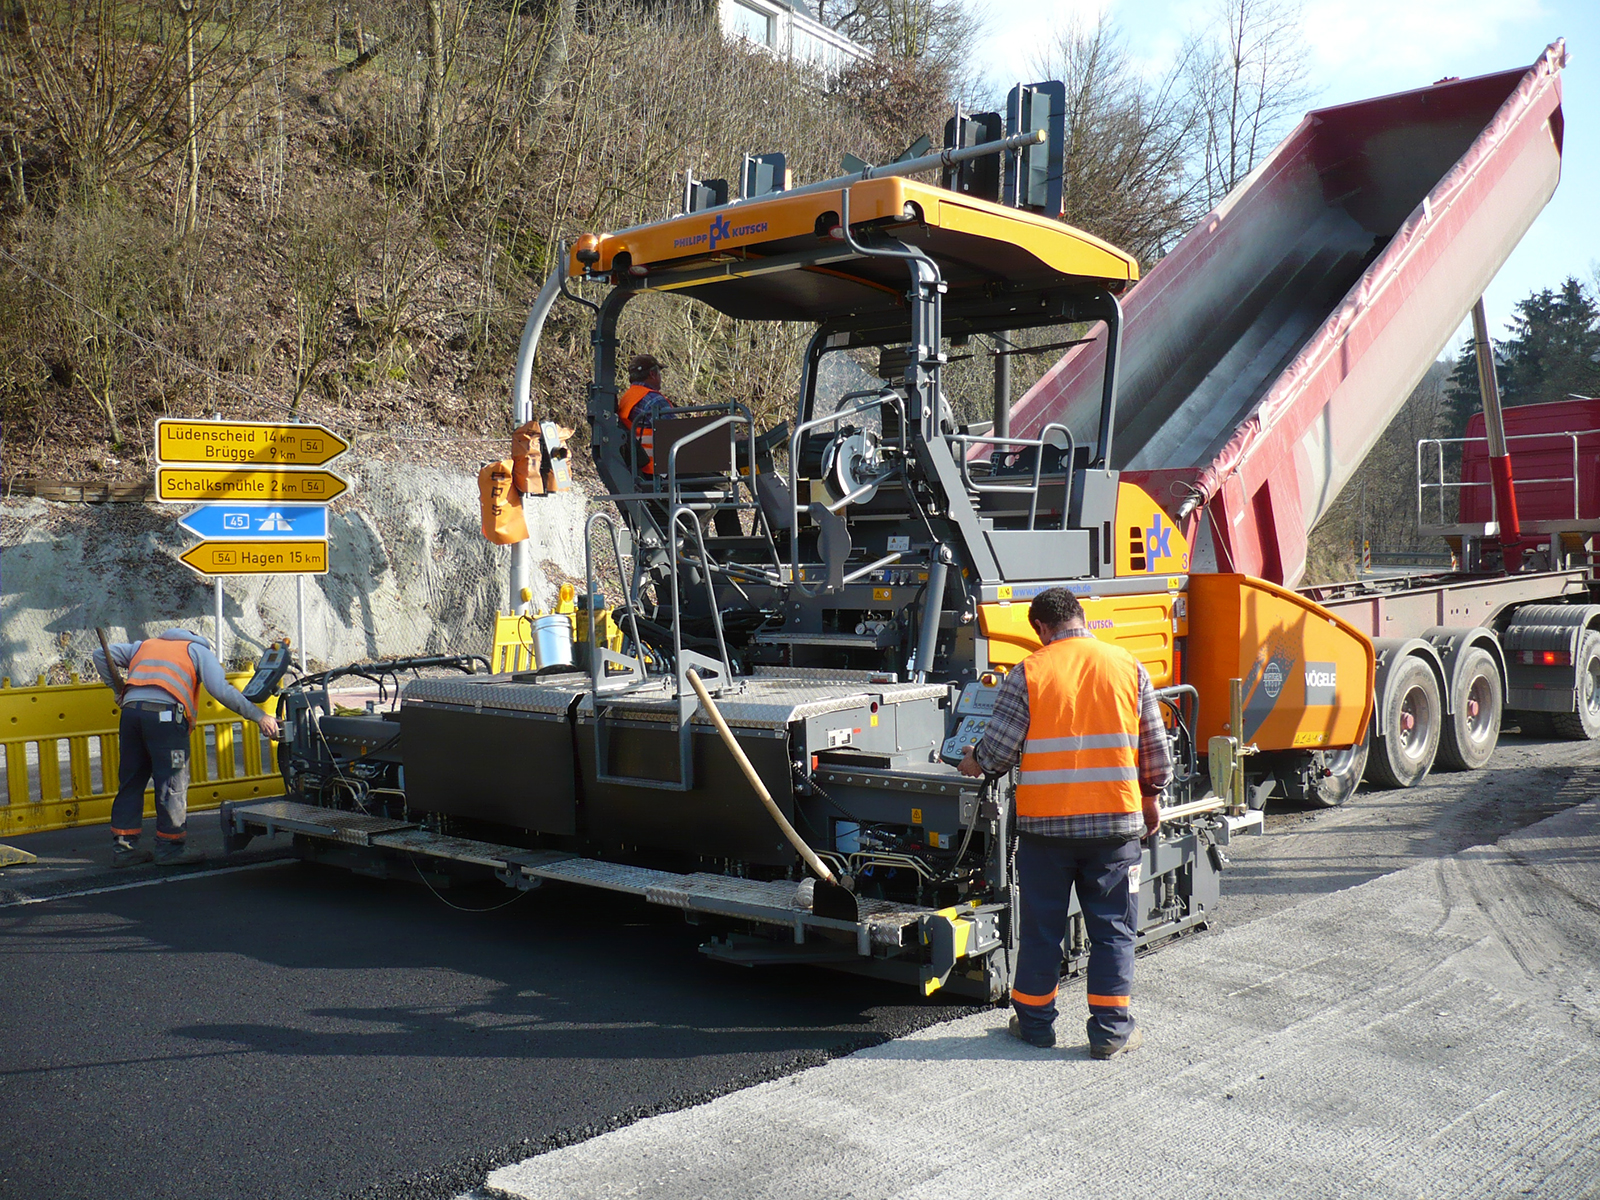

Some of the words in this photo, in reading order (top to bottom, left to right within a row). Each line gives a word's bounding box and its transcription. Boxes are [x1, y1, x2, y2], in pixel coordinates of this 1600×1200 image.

[674, 234, 708, 249] PHILIPP
[732, 222, 768, 238] KUTSCH
[167, 427, 255, 442] Lüdenscheid
[263, 431, 277, 443] 14
[280, 433, 296, 444] km
[205, 445, 255, 461] Brügge
[270, 447, 276, 459] 9
[280, 450, 296, 460] km
[306, 441, 318, 451] 54
[167, 479, 265, 492] Schalksmühle
[271, 480, 279, 492] 2
[282, 483, 297, 492] km
[307, 482, 319, 491] 54
[230, 516, 244, 527] 45
[218, 553, 231, 562] 54
[241, 552, 284, 566] Hagen
[290, 551, 303, 563] 15
[305, 554, 321, 563] km
[1182, 553, 1189, 570] 3
[1087, 619, 1114, 630] KUTSCH
[1305, 669, 1337, 687] VÖGELE
